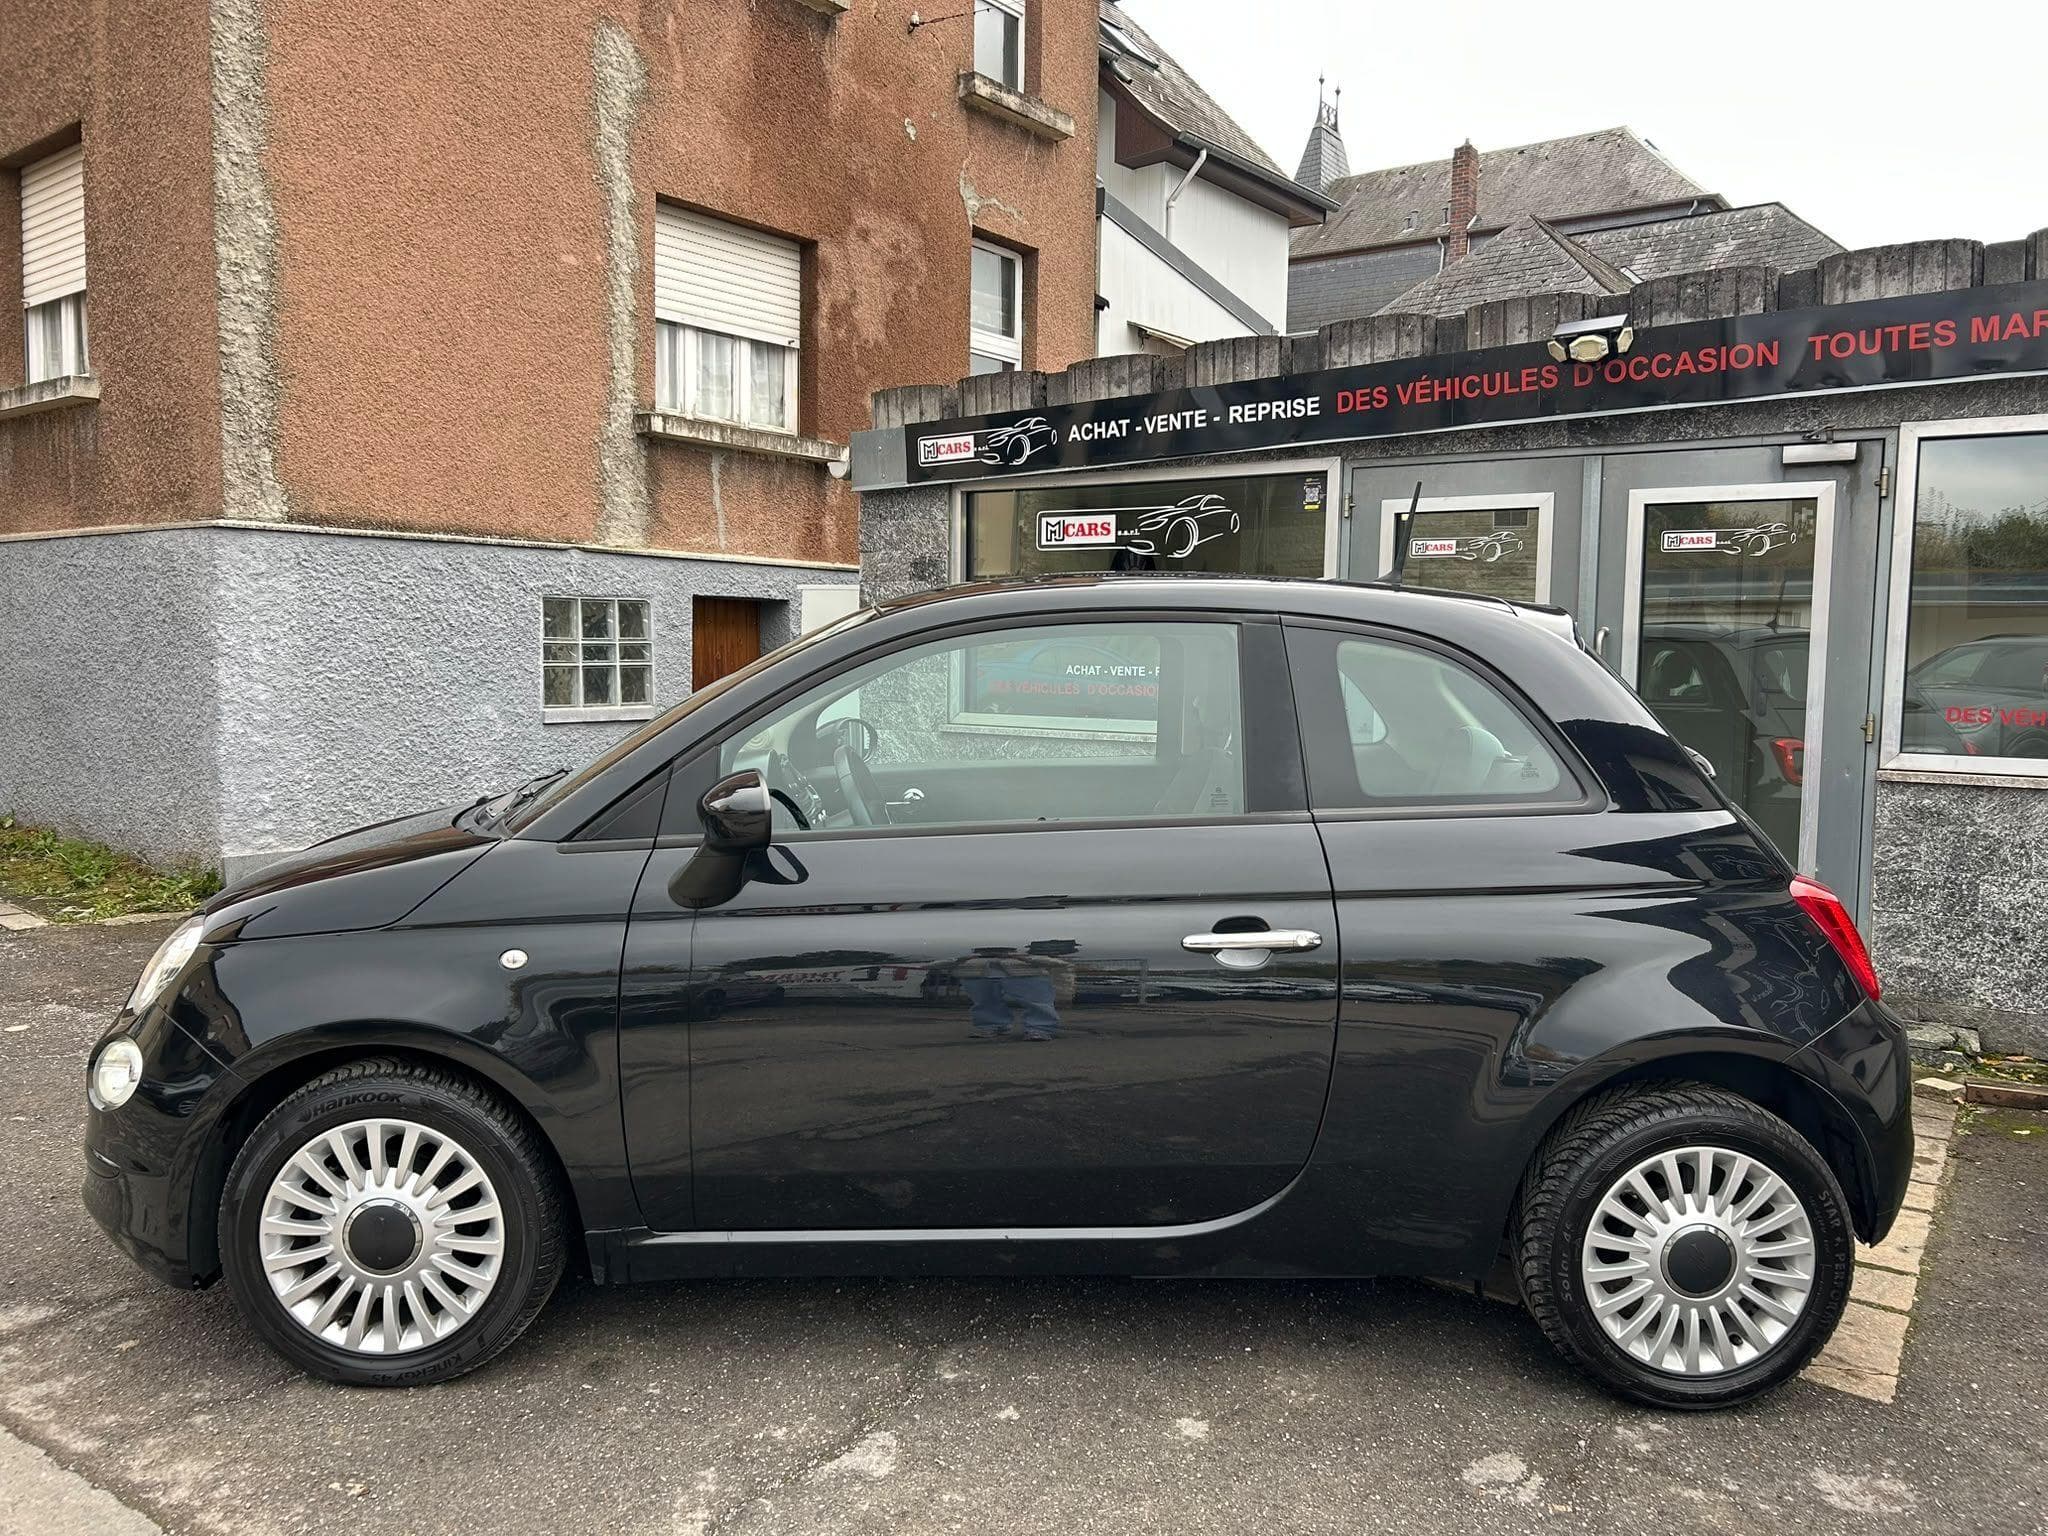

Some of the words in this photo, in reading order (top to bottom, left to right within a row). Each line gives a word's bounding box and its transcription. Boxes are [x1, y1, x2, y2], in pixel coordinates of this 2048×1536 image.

[1068, 419, 1131, 442] ACHAT
[1229, 396, 1321, 424] REPRISE
[1337, 385, 1389, 414] DES
[1395, 365, 1559, 406] VÉHICULES
[1572, 340, 1779, 388] D'OCCASION
[1807, 319, 1957, 361] TOUTES
[1066, 664, 1101, 676] ACHAT
[1109, 665, 1146, 677] VENTE
[1087, 683, 1160, 697] D'OCCASIO
[1944, 705, 1993, 724] DES
[2000, 704, 2048, 727] VÉH
